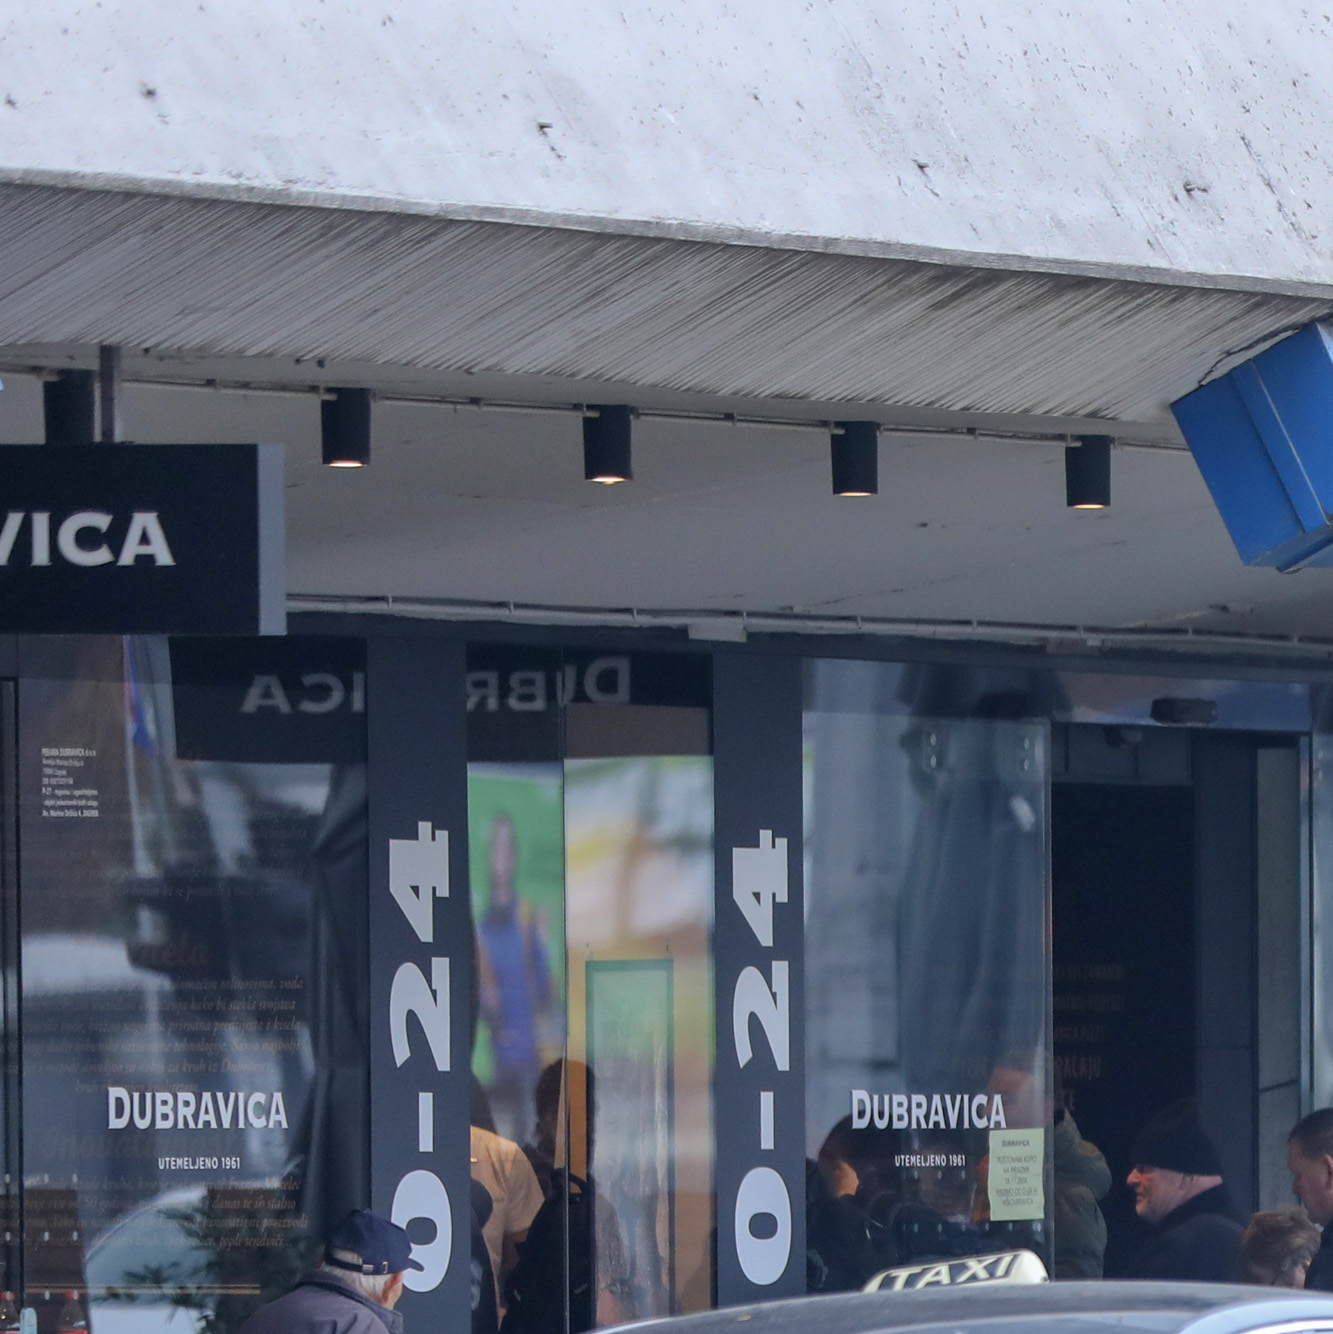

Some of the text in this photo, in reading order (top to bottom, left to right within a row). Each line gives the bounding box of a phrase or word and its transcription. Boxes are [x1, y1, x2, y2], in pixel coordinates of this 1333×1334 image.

[388, 820, 452, 1293] 0-24
[732, 829, 792, 1286] 0-24
[108, 1087, 288, 1129] DUBRAVICA
[852, 1089, 1006, 1129] DUBRAVICA
[158, 1157, 241, 1170] UTEMELJENO 1961
[895, 1154, 966, 1167] UTEMELJENO 1961
[890, 1255, 1015, 1291] TAXI
